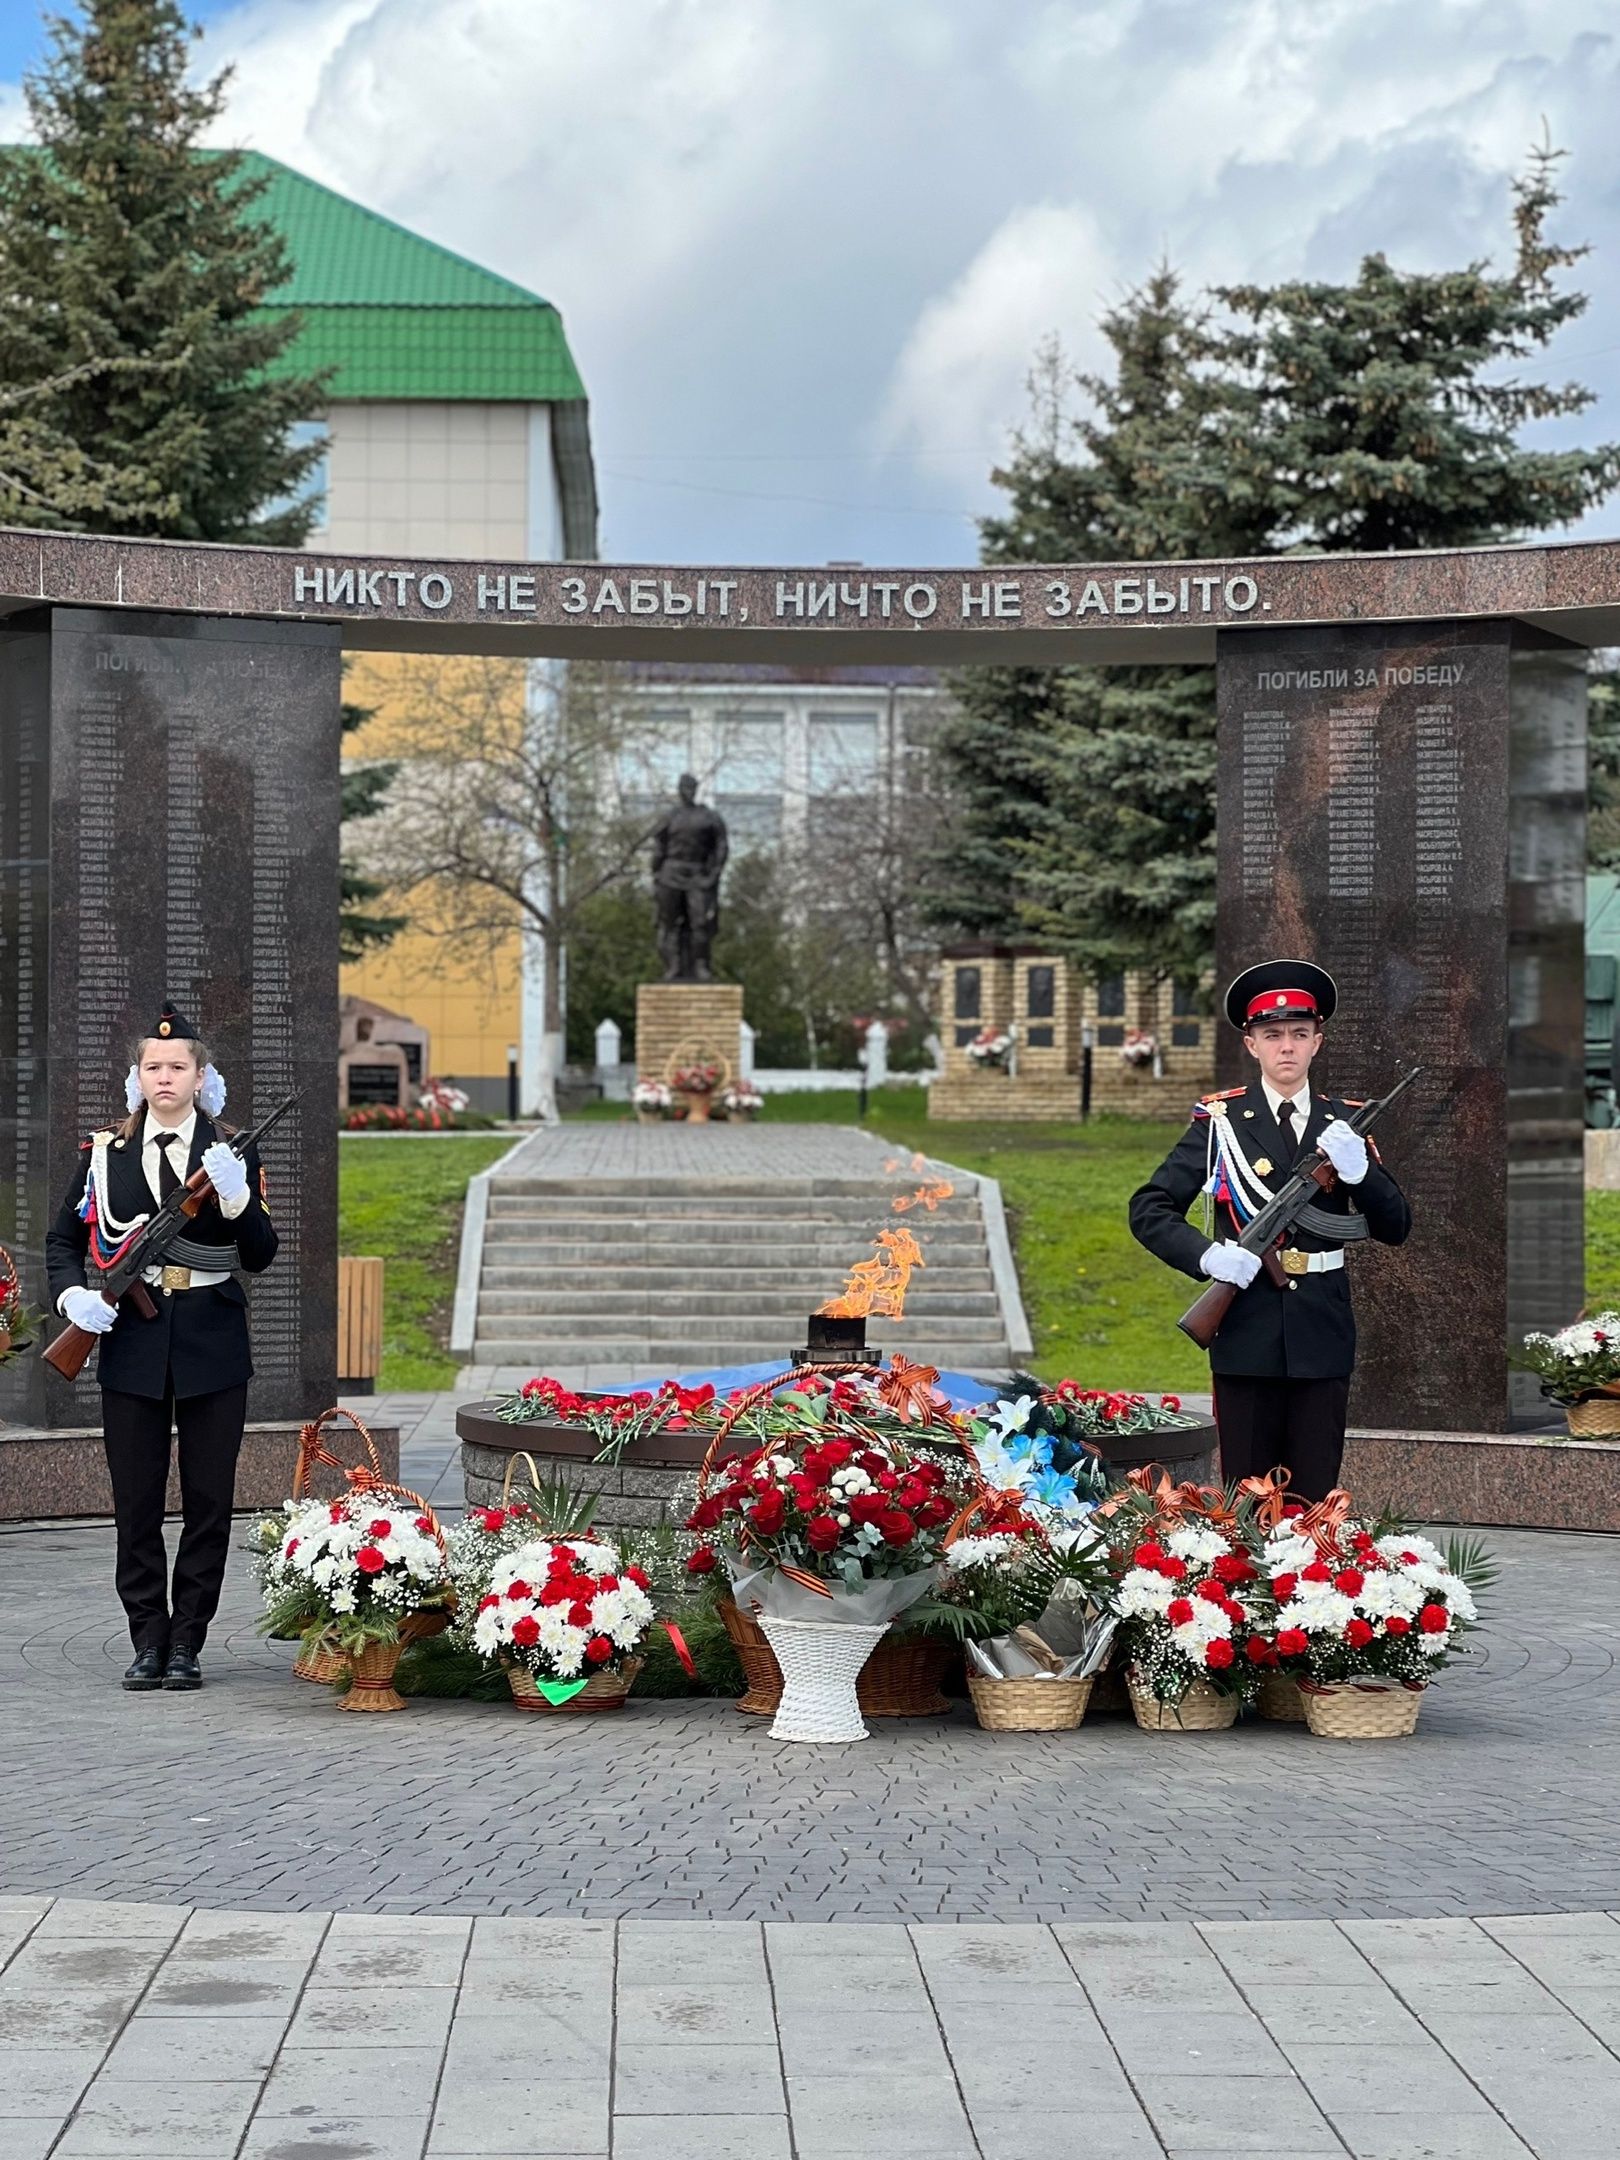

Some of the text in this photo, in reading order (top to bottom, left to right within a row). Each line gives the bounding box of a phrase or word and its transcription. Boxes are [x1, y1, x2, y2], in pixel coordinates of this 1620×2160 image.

[294, 566, 1272, 622] НИКТО НЕ ЗАБЫТ, НИЧТО НЕ ЗАБЫТО.
[95, 651, 184, 674] ПОГИБЛ
[1257, 665, 1465, 690] ПОГИБЛИ ЗА ПОБЕДУ
